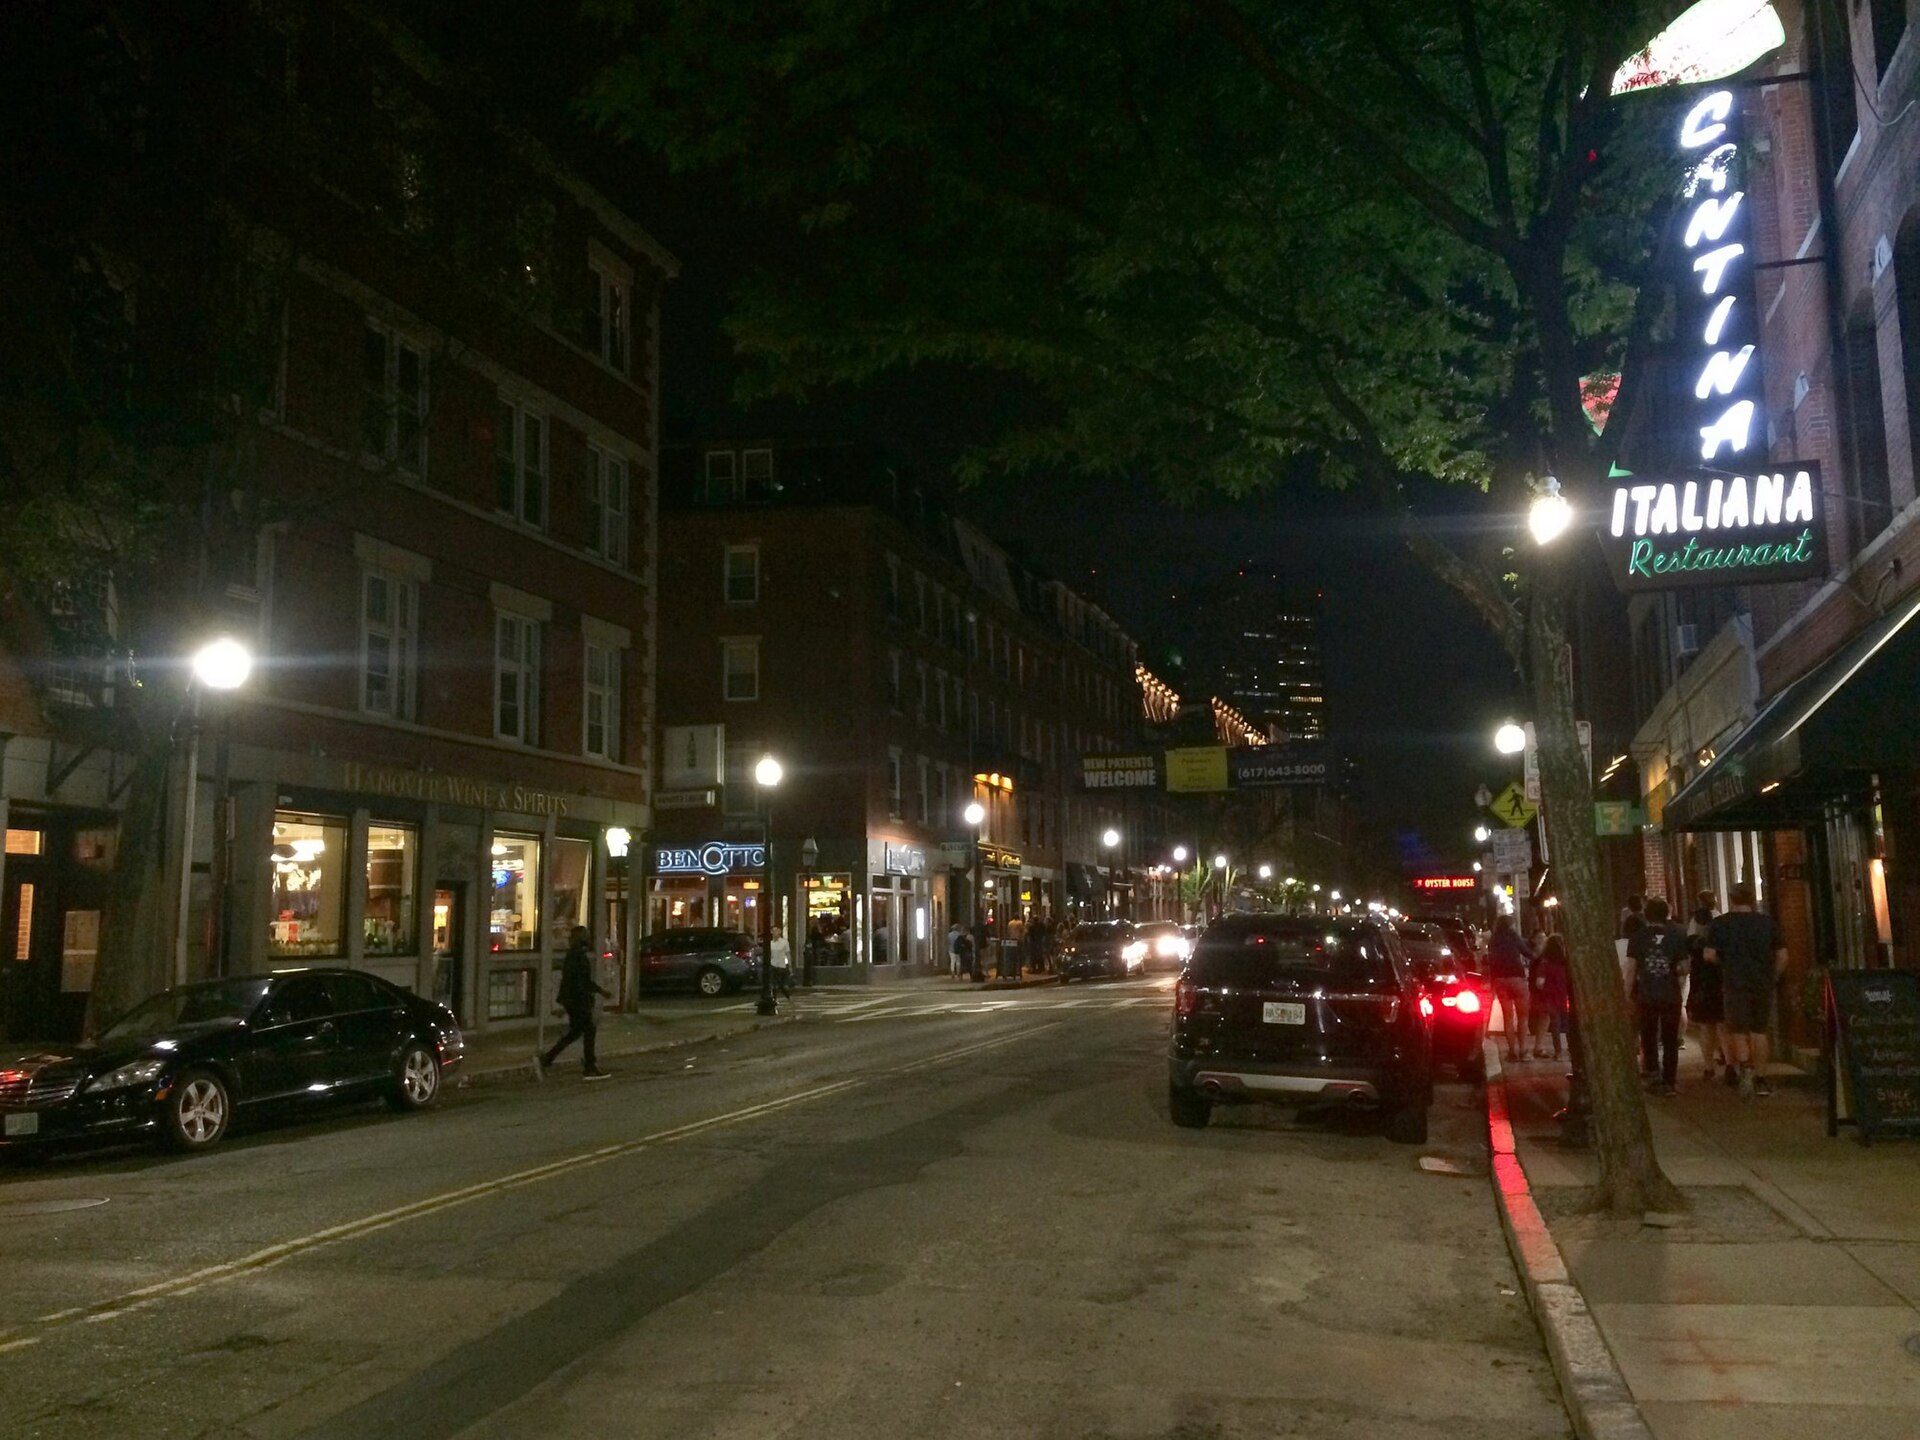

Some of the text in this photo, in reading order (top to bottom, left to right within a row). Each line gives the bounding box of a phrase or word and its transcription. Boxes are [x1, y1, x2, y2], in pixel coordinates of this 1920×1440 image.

[1679, 91, 1756, 459] CANTINA
[1611, 471, 1813, 537] ITALIANA
[1629, 528, 1813, 578] Restaurant
[1084, 769, 1157, 788] WELCOME
[498, 789, 507, 808] &
[513, 786, 568, 816] SPIRITS
[1424, 878, 1451, 888] OYSTER
[1452, 878, 1475, 887] HOUSE
